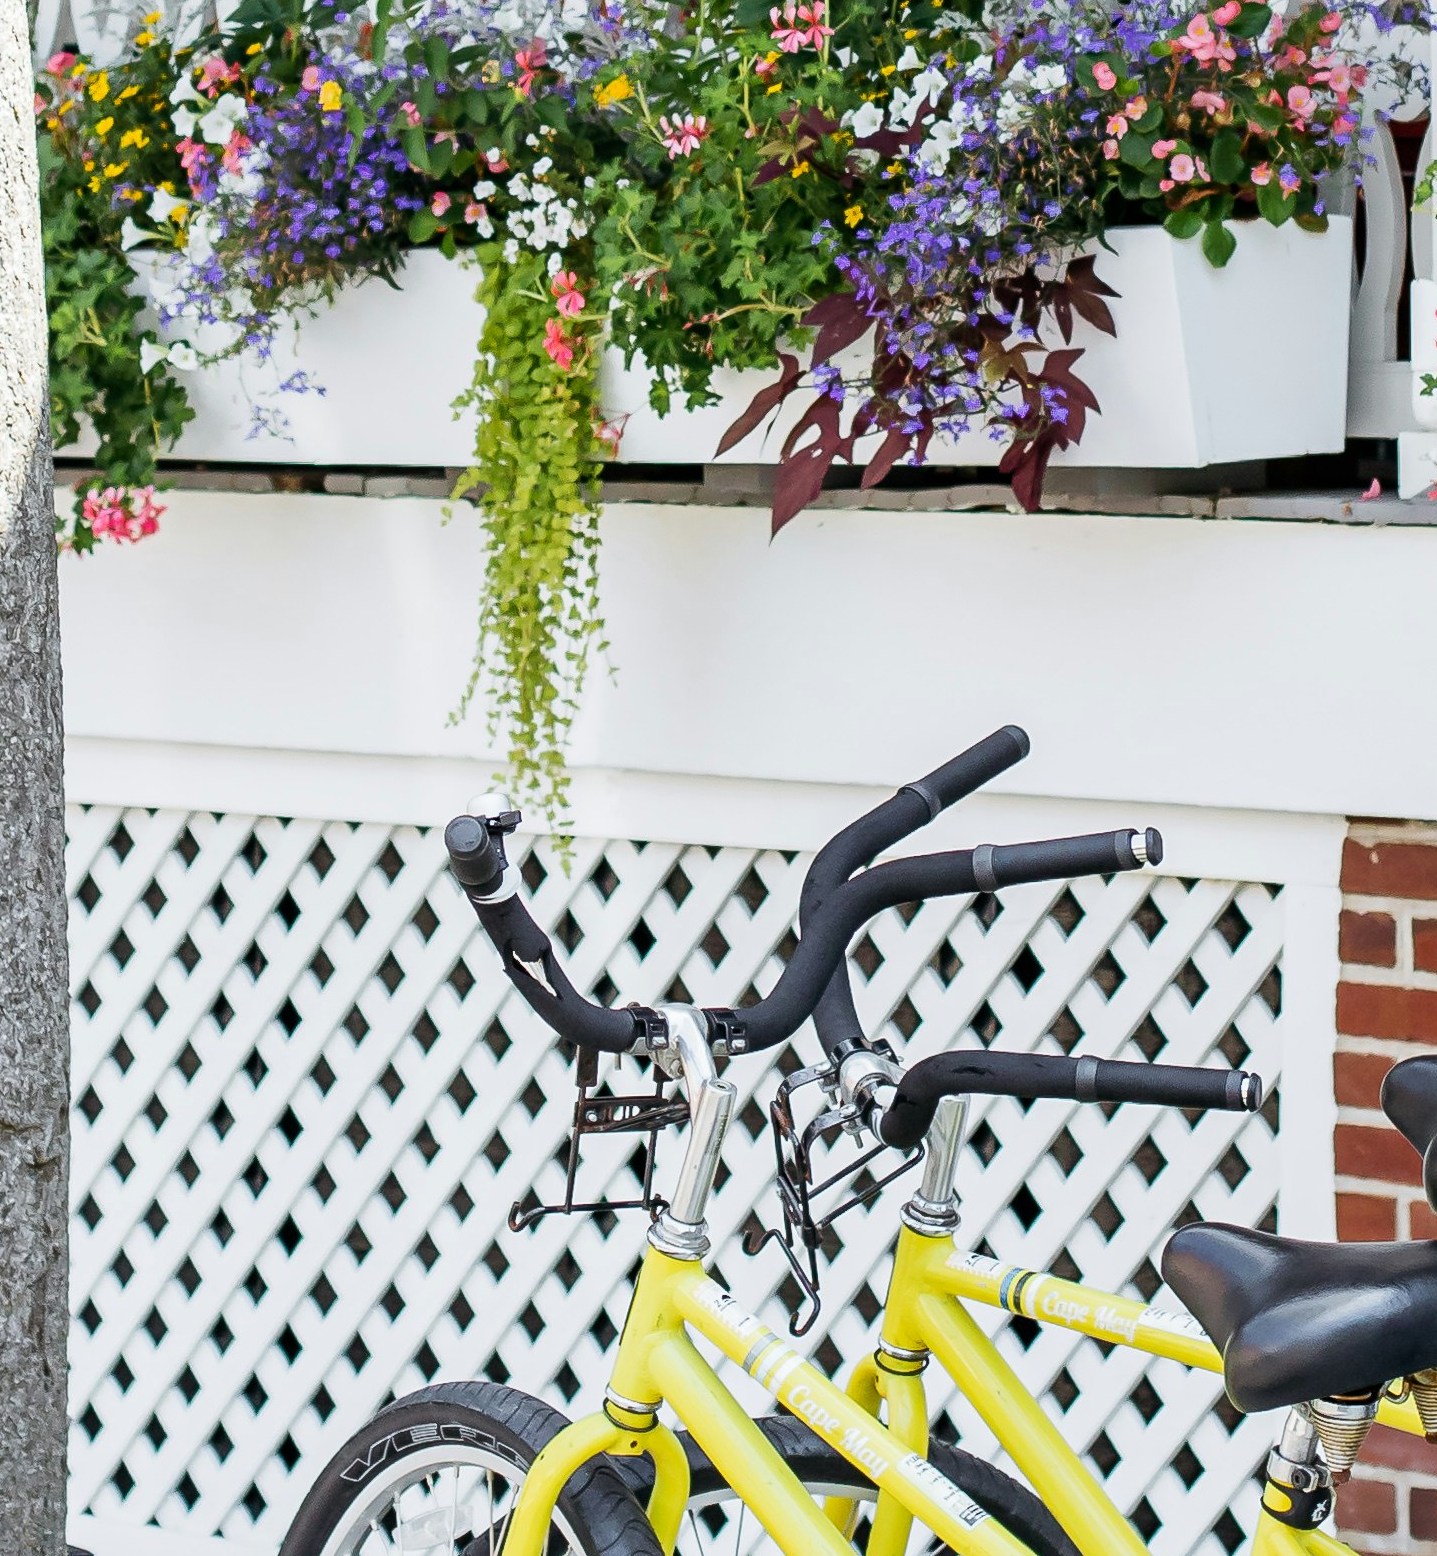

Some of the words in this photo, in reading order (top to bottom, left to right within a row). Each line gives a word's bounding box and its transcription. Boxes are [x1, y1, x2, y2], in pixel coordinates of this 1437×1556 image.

[1043, 1290, 1091, 1325] Cape
[1094, 1305, 1138, 1343] May
[788, 1384, 841, 1435] Cape
[839, 1427, 891, 1479] May
